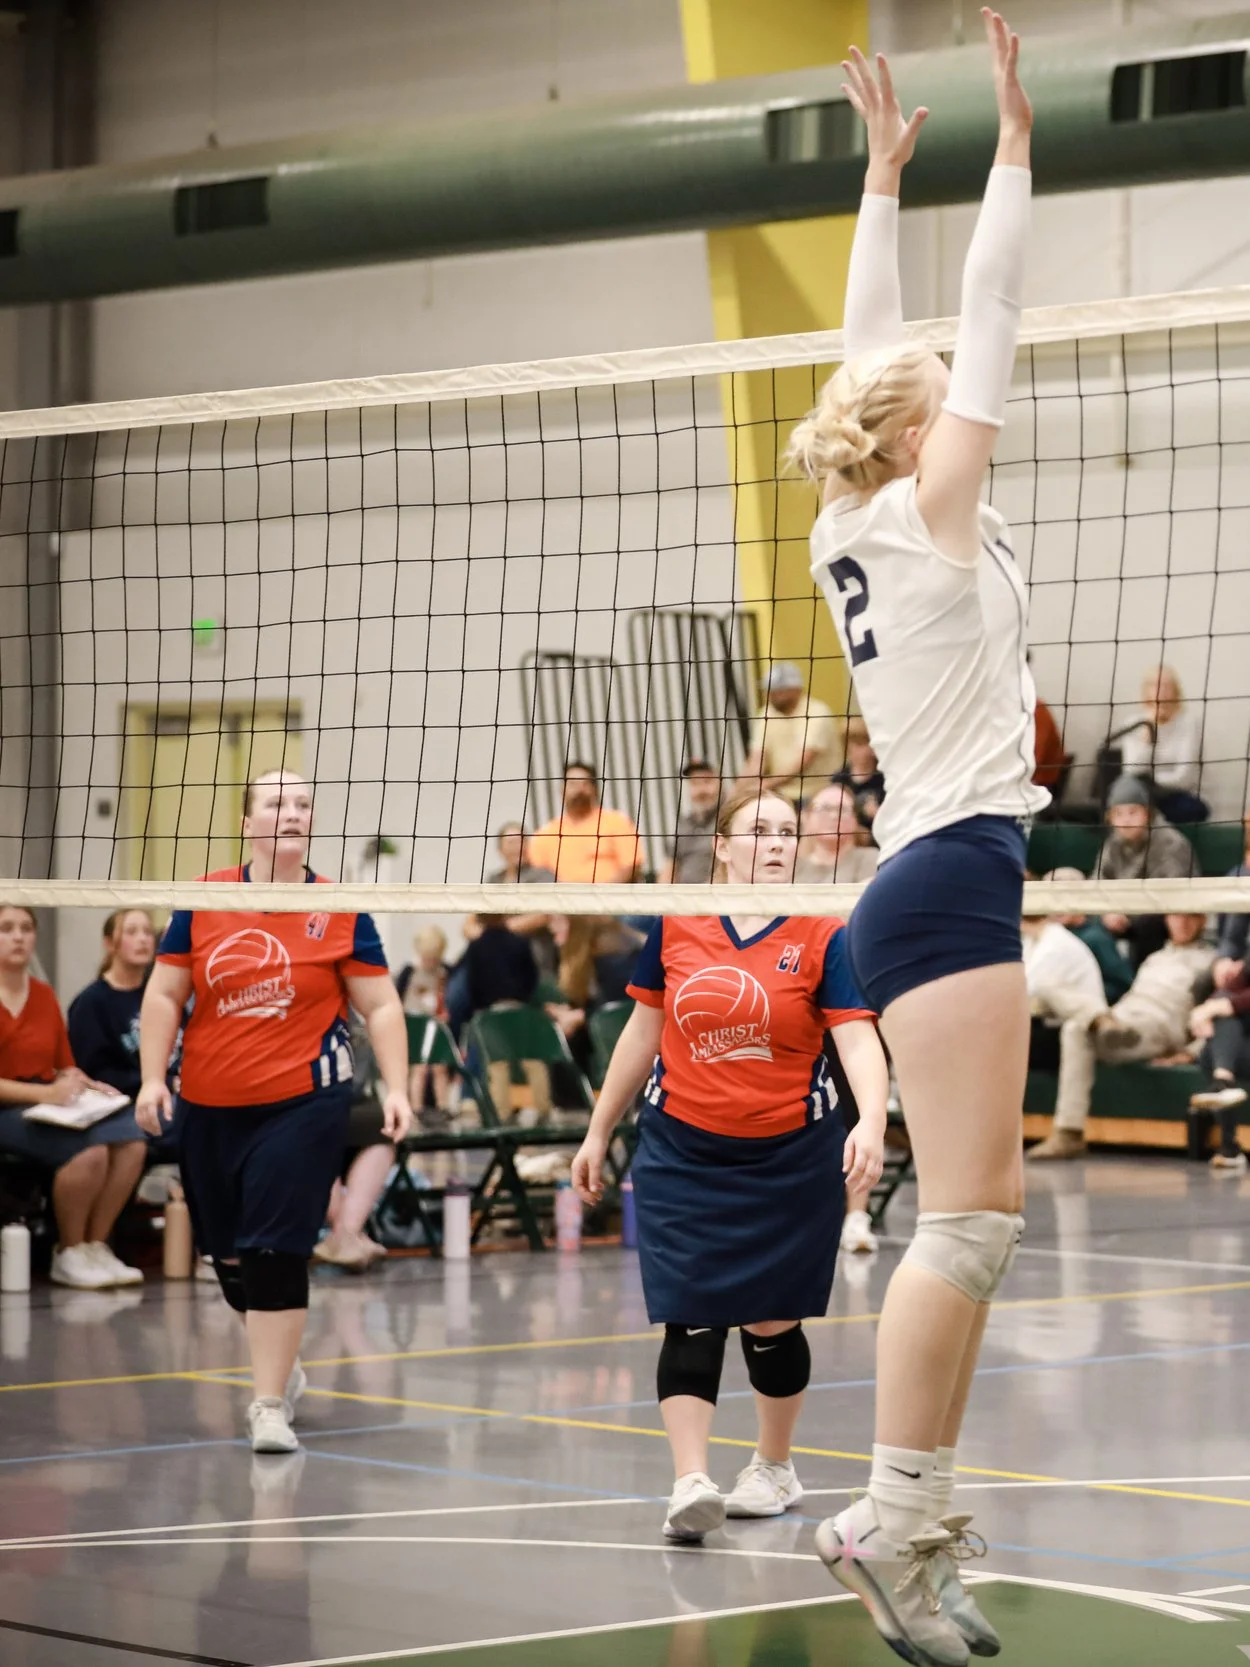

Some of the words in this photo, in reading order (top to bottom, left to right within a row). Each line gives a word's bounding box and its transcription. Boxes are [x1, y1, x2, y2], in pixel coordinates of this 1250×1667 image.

[827, 555, 879, 668] 2
[776, 943, 806, 975] 21
[698, 1023, 759, 1047] CHRIST
